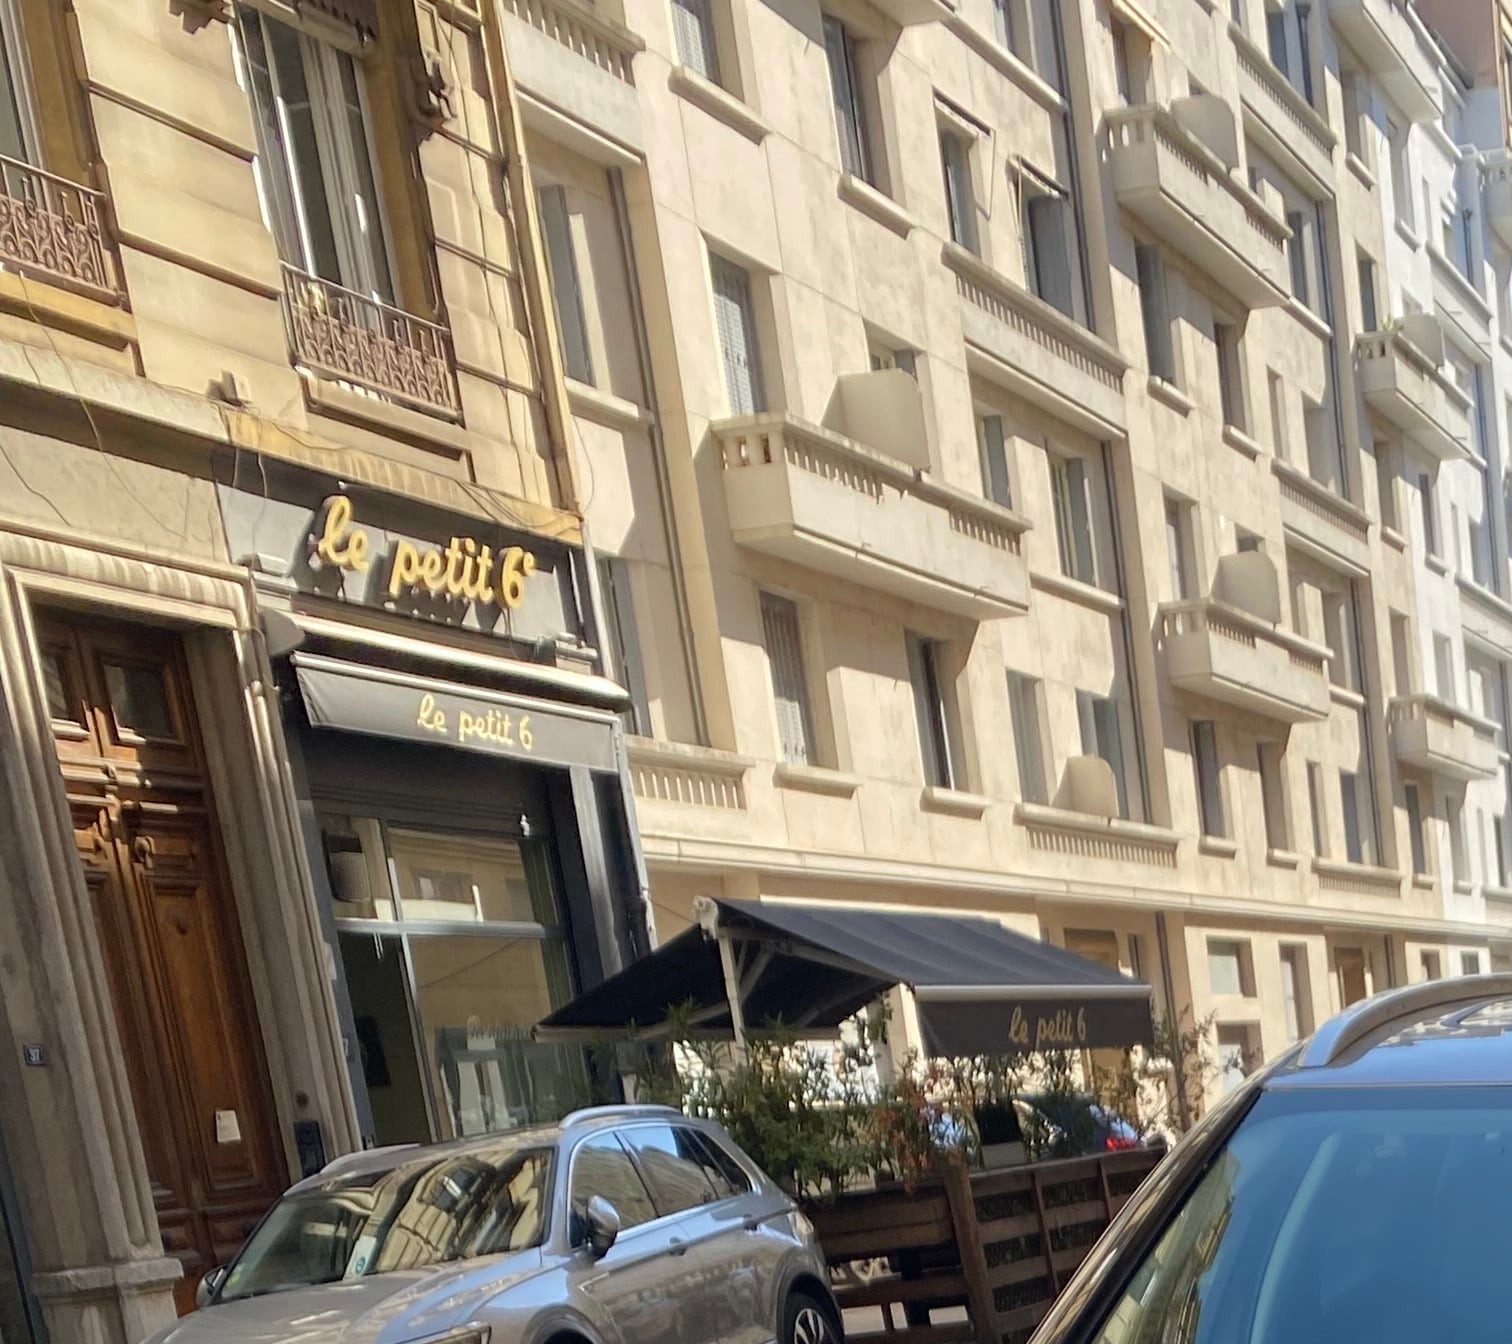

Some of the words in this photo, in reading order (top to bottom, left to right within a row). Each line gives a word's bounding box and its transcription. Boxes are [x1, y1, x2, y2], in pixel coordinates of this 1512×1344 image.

[389, 536, 494, 603] petit
[459, 709, 514, 745] petit
[519, 715, 533, 751] 6
[1035, 1008, 1074, 1050] petit
[1076, 1006, 1088, 1041] 6
